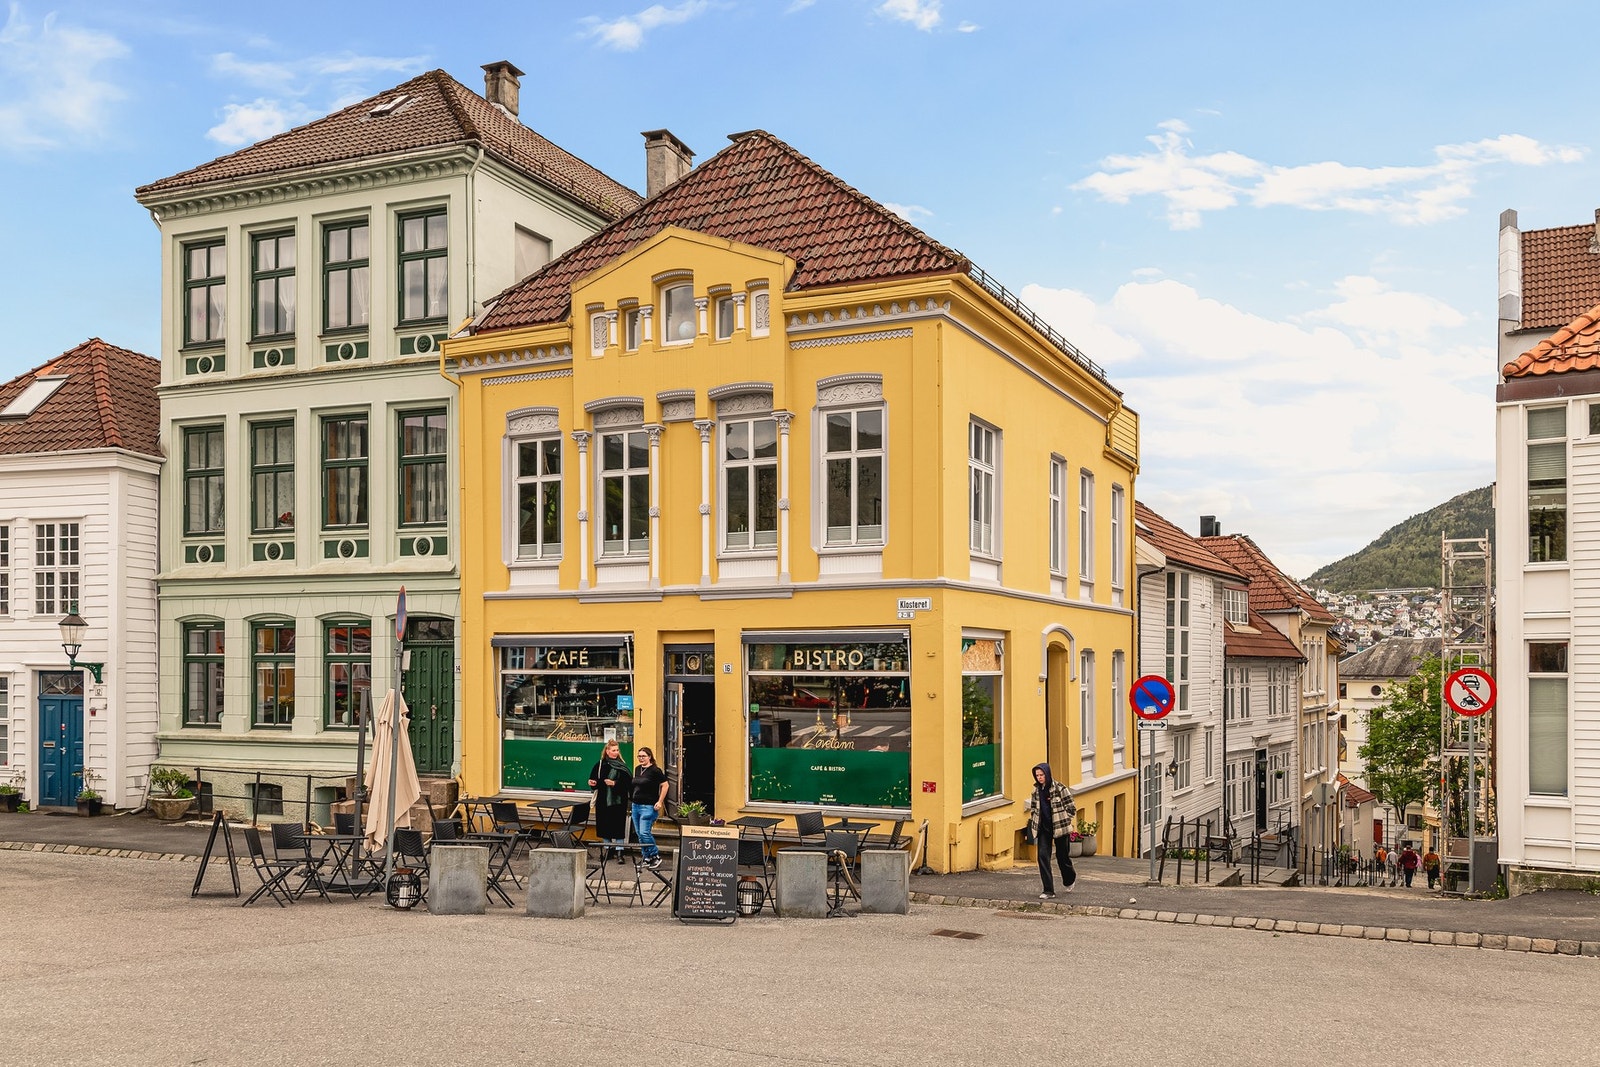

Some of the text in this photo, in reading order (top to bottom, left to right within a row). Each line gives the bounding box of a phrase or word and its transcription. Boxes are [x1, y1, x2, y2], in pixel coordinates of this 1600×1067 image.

[900, 600, 928, 608] Klosteret
[546, 648, 588, 665] CAFÉ
[794, 650, 864, 666] BISTRO
[688, 840, 727, 850] The 5 Love
[683, 850, 736, 864] languages
